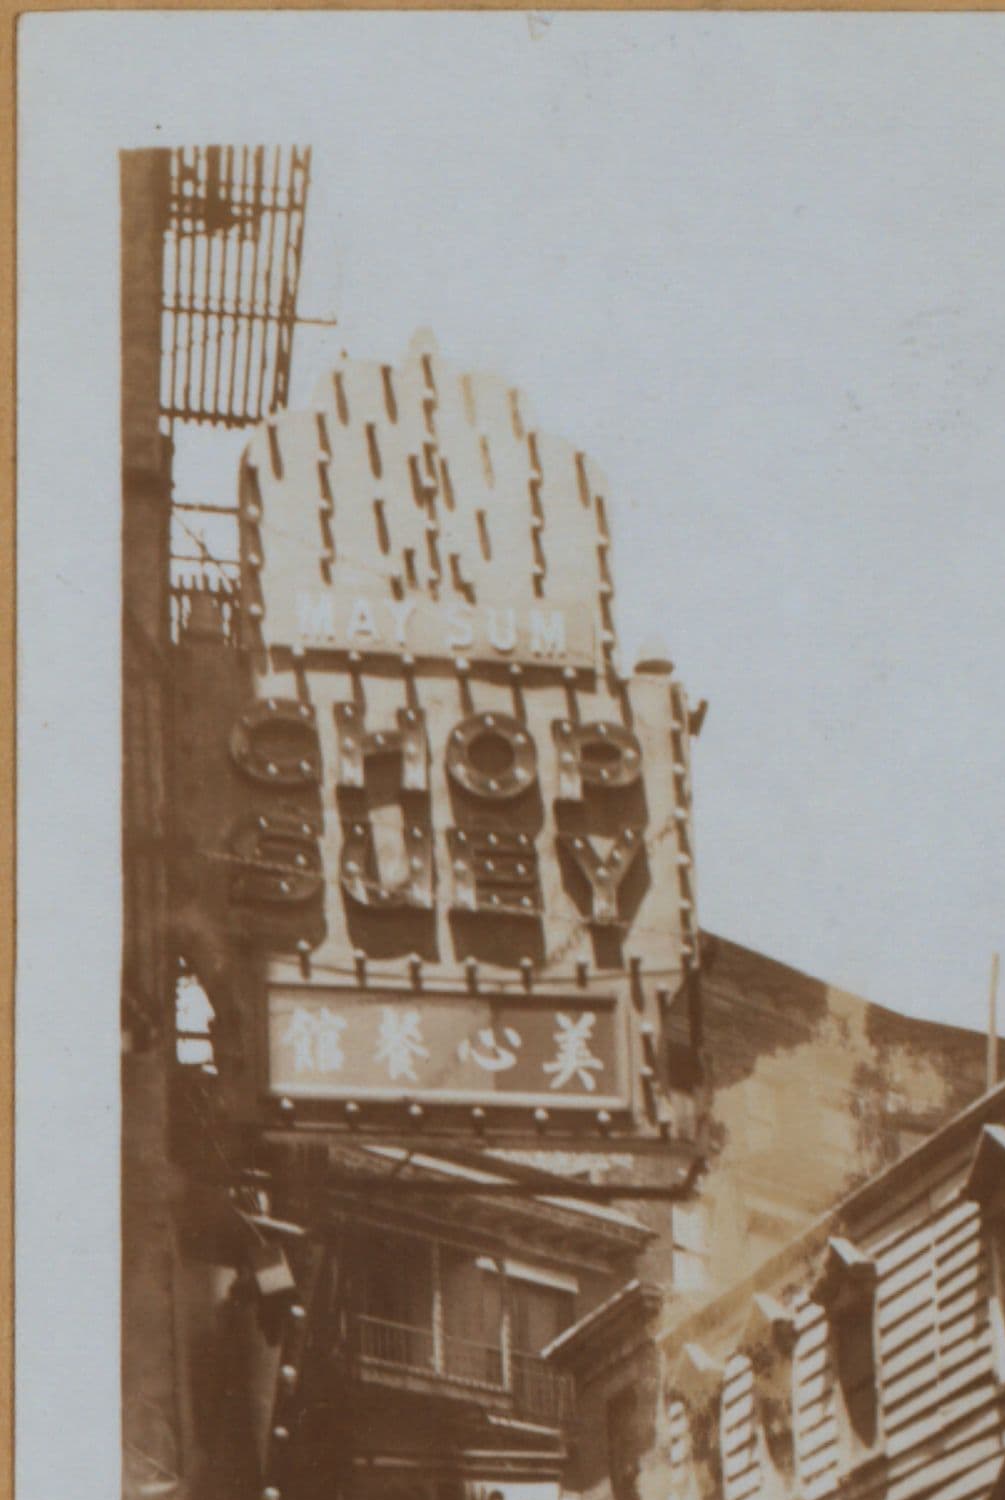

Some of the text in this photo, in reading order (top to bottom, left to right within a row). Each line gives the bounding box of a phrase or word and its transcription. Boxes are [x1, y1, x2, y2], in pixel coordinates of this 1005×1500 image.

[296, 592, 569, 660] MAY SUM
[229, 698, 643, 800] CHOP
[227, 803, 647, 919] SUEY
